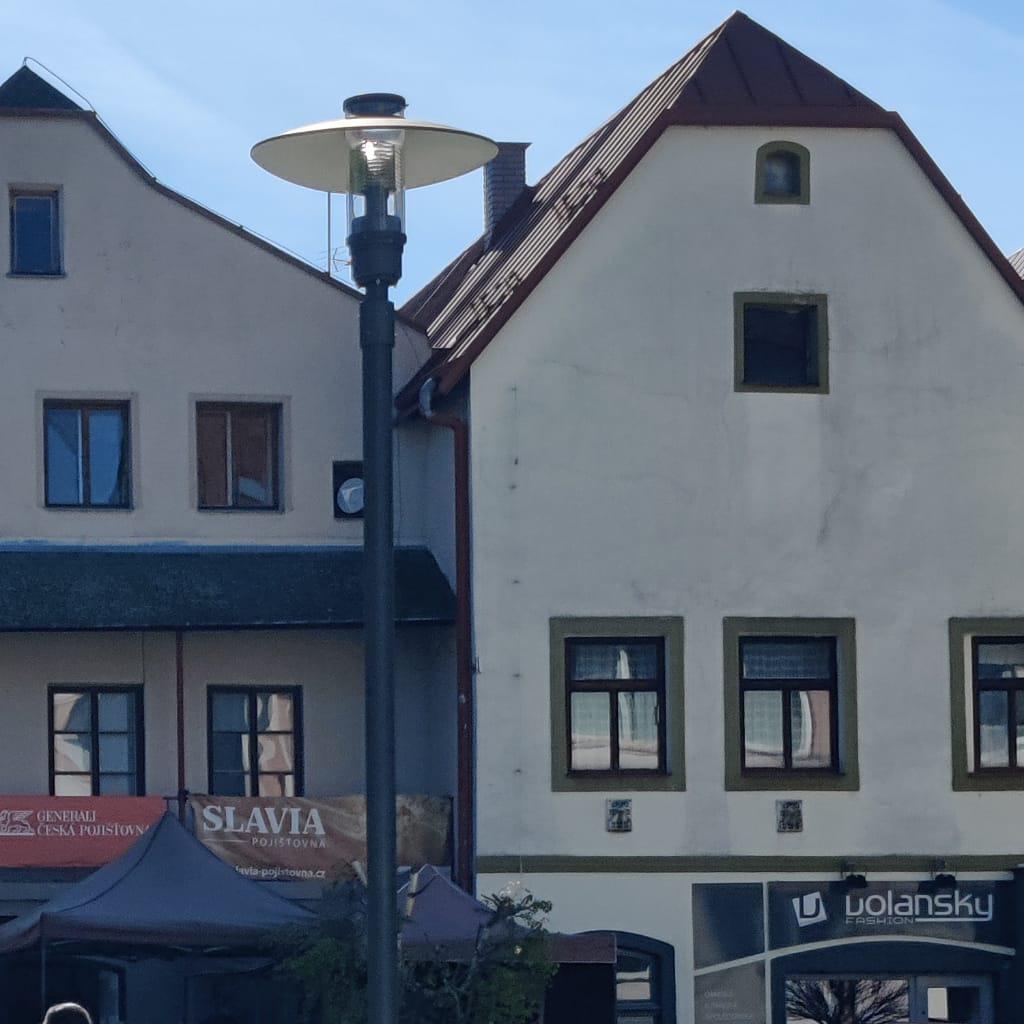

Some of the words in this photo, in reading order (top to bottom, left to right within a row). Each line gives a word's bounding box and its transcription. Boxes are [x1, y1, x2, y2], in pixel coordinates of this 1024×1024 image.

[36, 810, 96, 822] GENERALI
[202, 805, 326, 835] SLAVIA
[36, 822, 76, 836] ČESKÁ
[845, 917, 915, 925] FASHION
